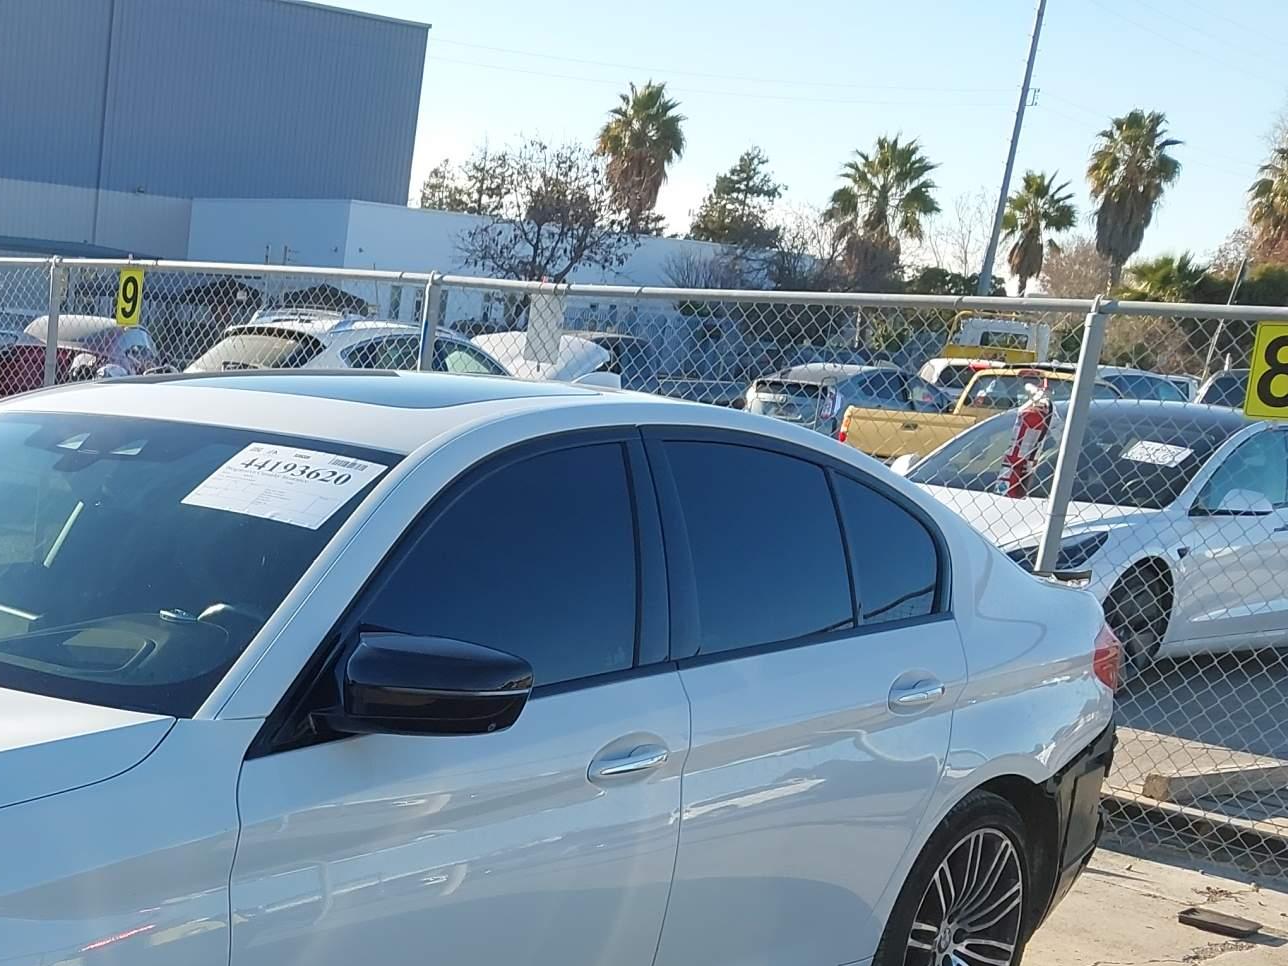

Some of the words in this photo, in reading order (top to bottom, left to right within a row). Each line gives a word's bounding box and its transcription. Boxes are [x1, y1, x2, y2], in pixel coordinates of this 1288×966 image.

[121, 276, 138, 318] 9
[1257, 335, 1288, 407] 8
[241, 457, 352, 486] 44193620
